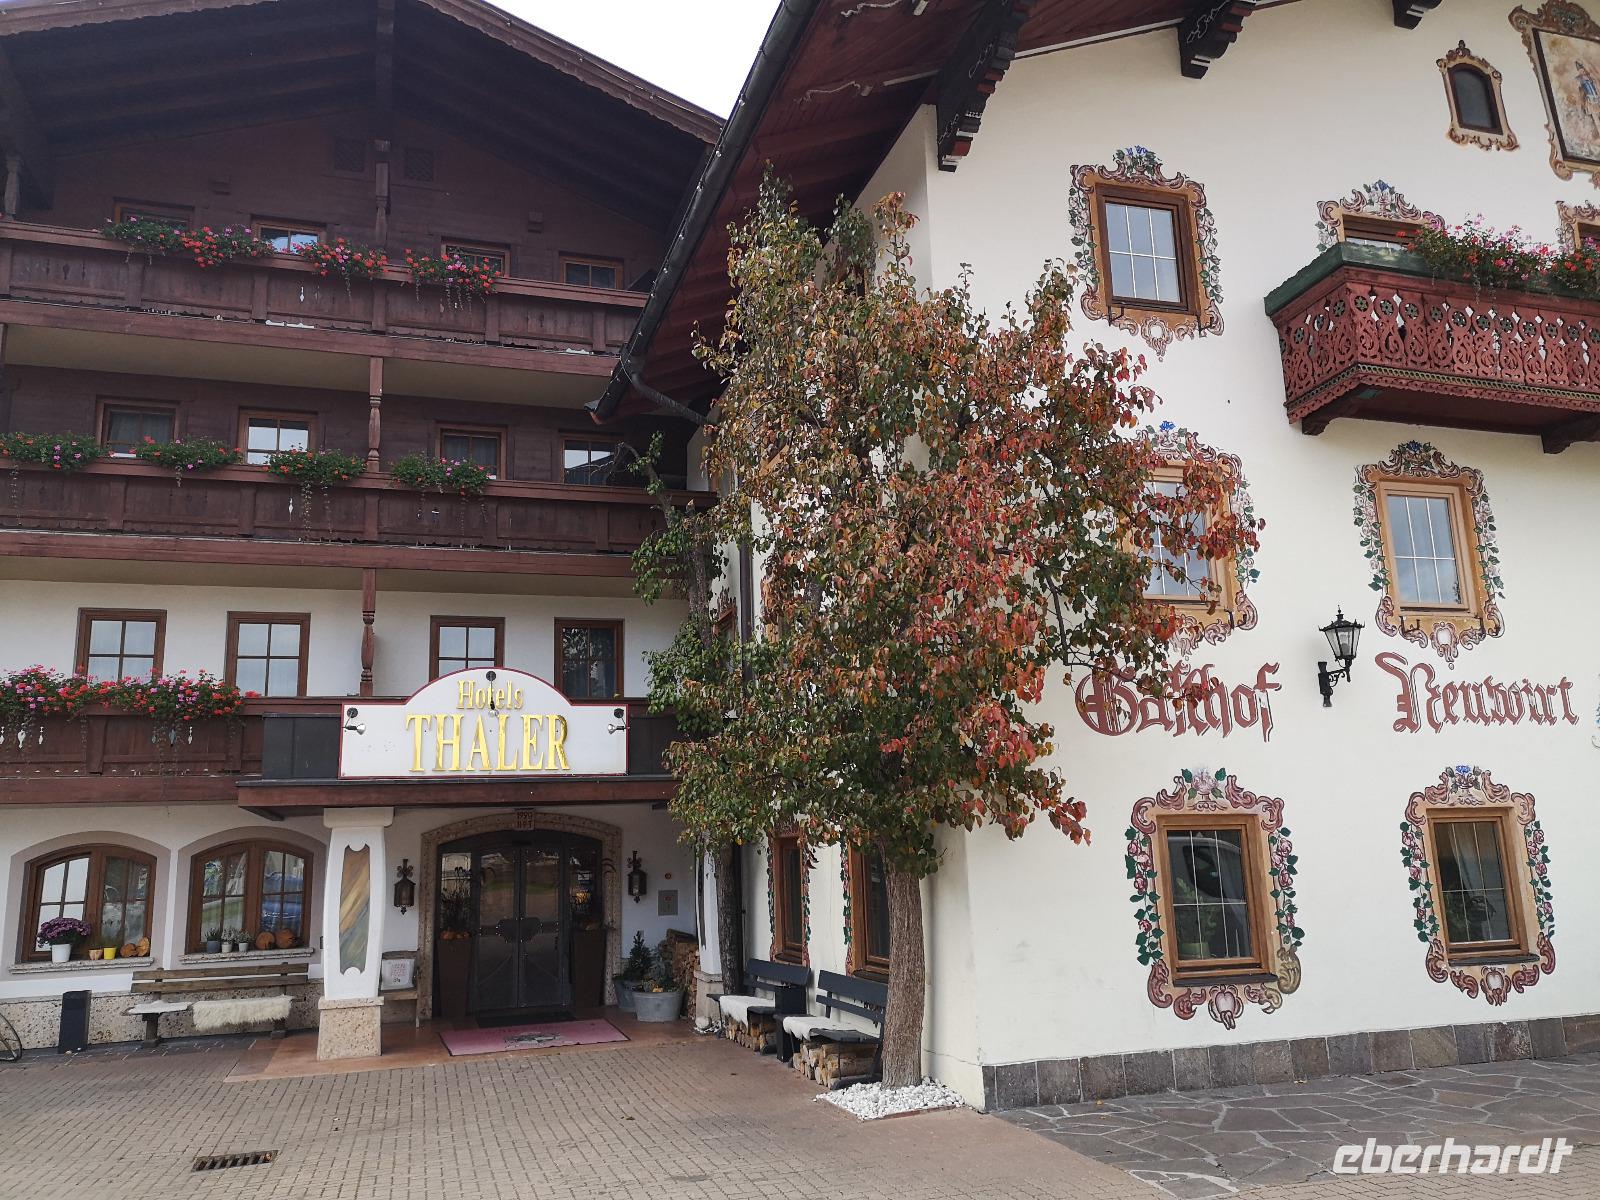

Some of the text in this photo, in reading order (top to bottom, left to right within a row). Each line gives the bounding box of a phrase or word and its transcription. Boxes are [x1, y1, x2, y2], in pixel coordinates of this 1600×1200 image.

[456, 680, 525, 710] Hotels
[1374, 651, 1580, 734] Neuwirt
[405, 713, 571, 773] THALER
